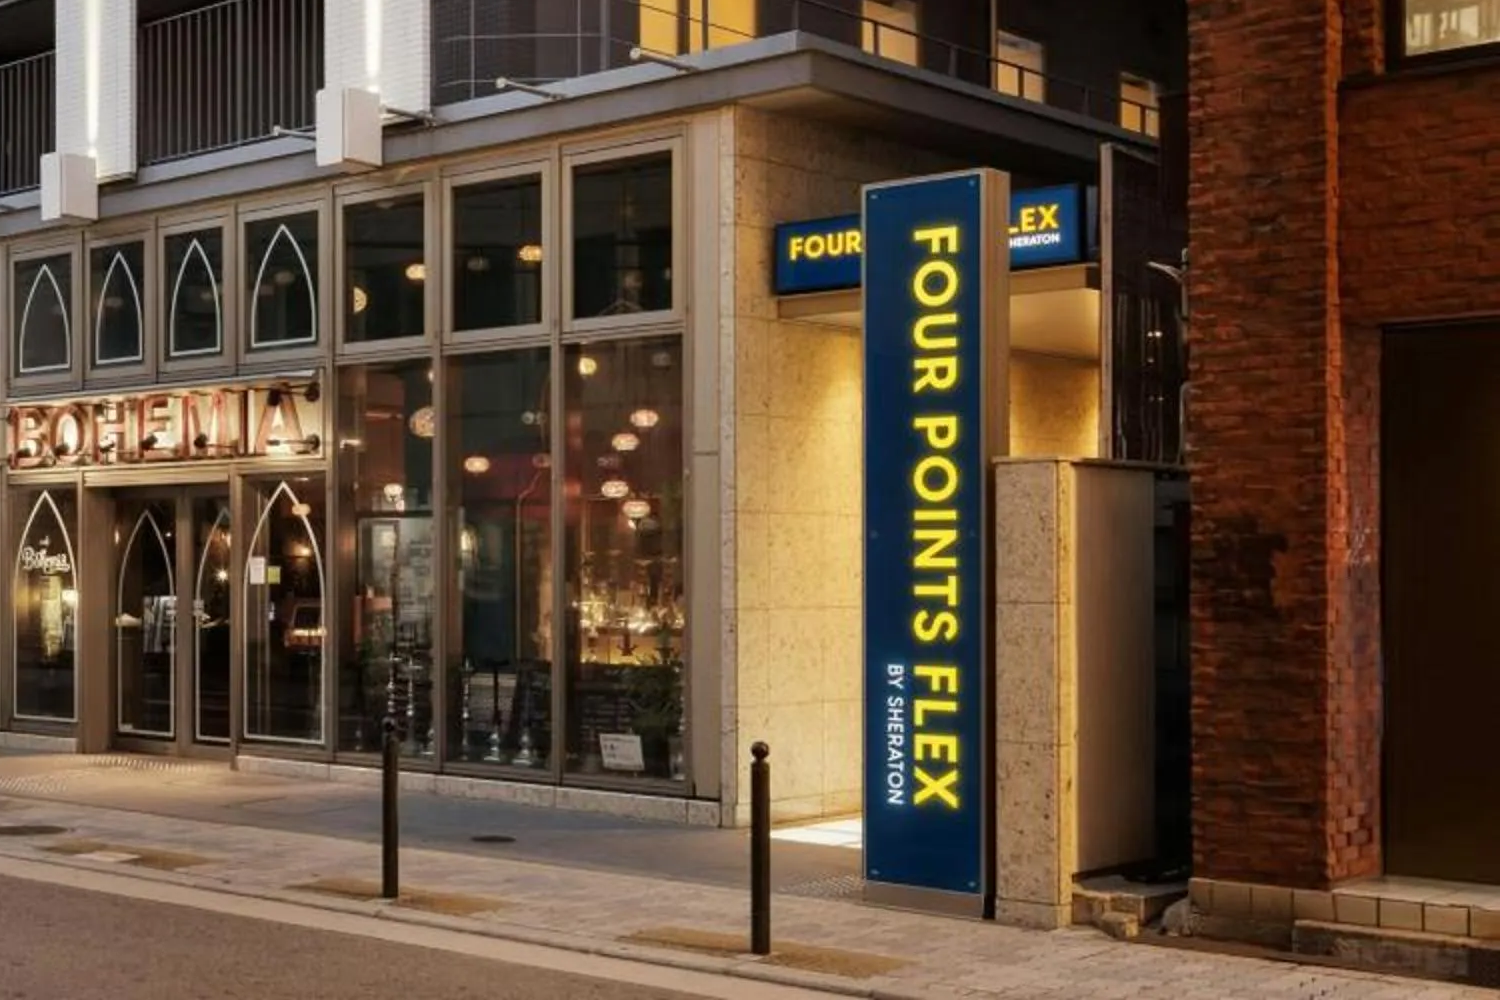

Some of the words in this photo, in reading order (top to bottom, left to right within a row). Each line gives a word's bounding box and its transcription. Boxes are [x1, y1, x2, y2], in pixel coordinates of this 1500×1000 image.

[789, 229, 863, 261] FOUR
[1009, 232, 1061, 248] HERATON
[913, 225, 959, 393] FOUR
[6, 382, 307, 470] BOHEMIA
[913, 415, 959, 642] POINTS
[887, 664, 905, 690] BY
[887, 696, 905, 805] SHERATON
[913, 664, 960, 809] FLEX
